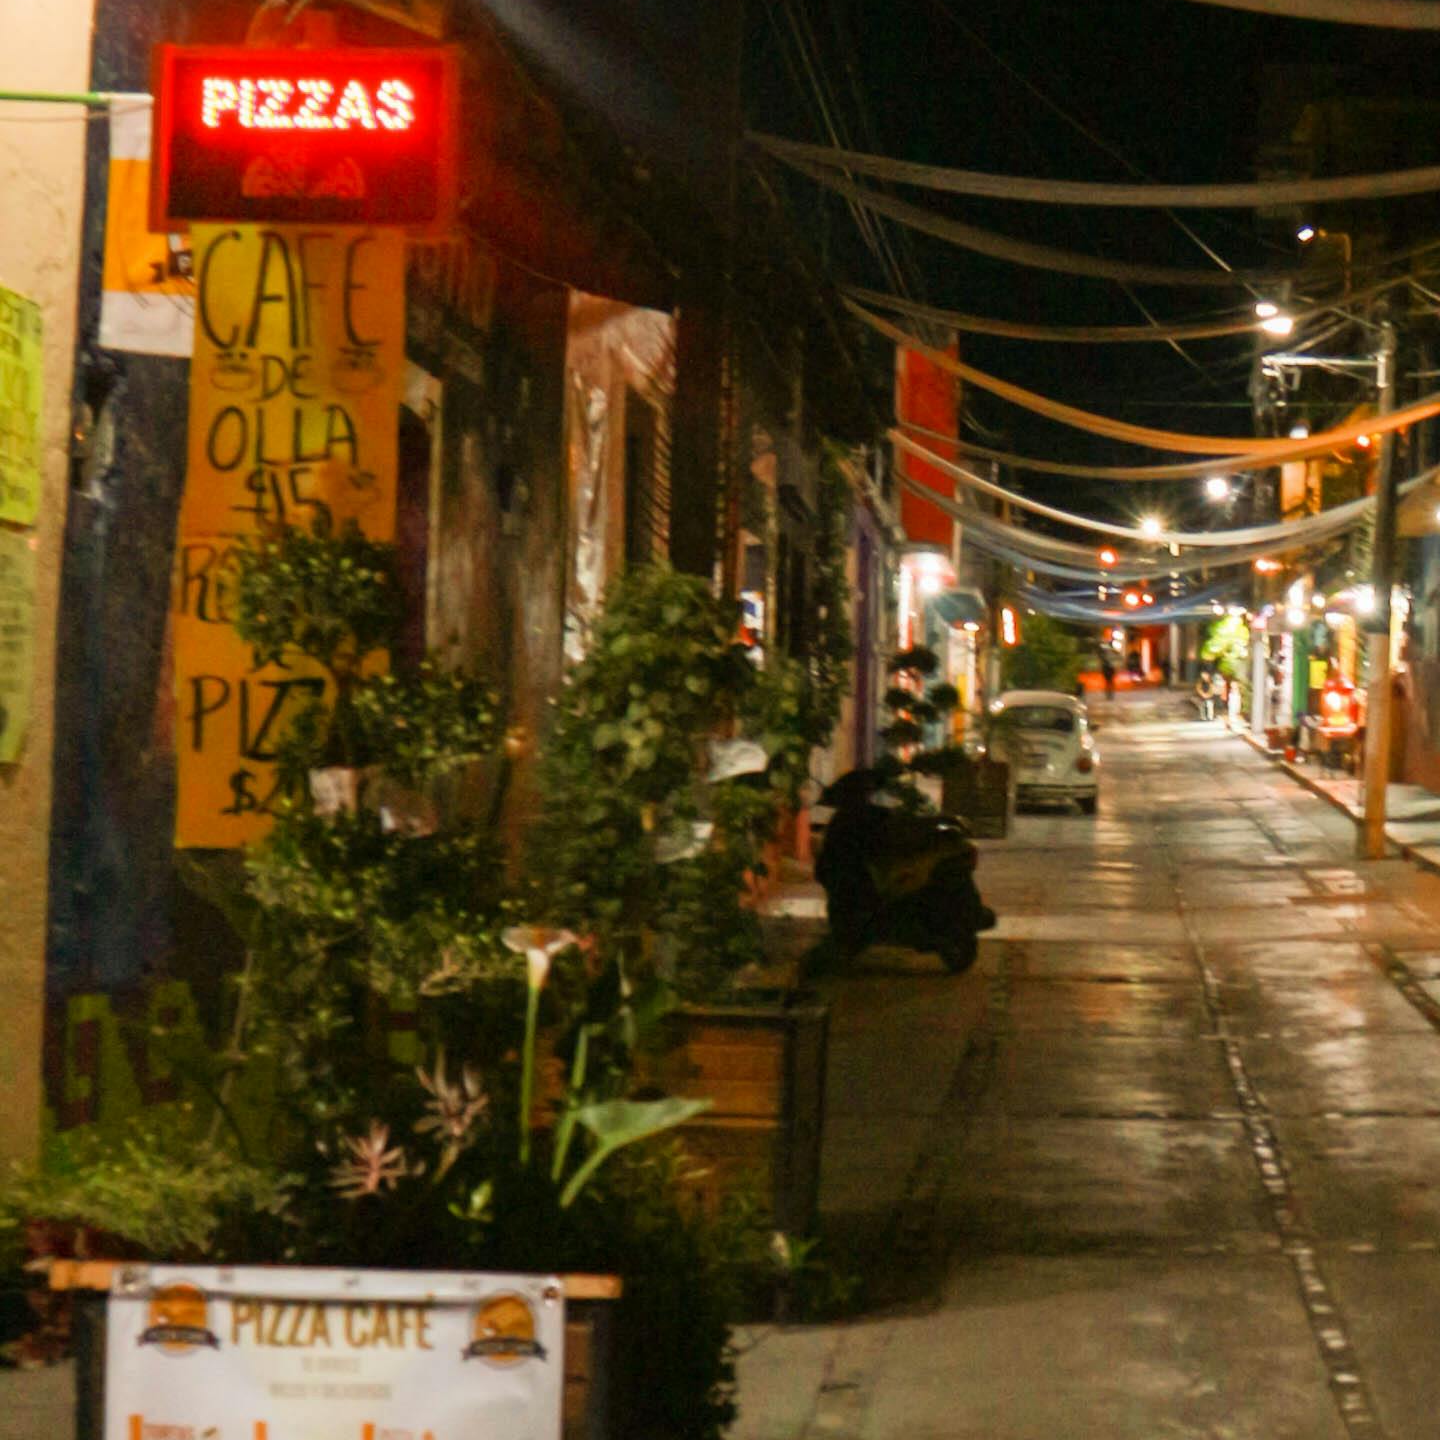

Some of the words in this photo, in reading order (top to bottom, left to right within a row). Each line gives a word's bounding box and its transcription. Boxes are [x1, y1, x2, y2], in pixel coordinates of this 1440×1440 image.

[202, 76, 415, 130] PIZZAS
[254, 354, 318, 401] DE
[207, 404, 357, 473] OLLA
[230, 1299, 332, 1347] PIZZA
